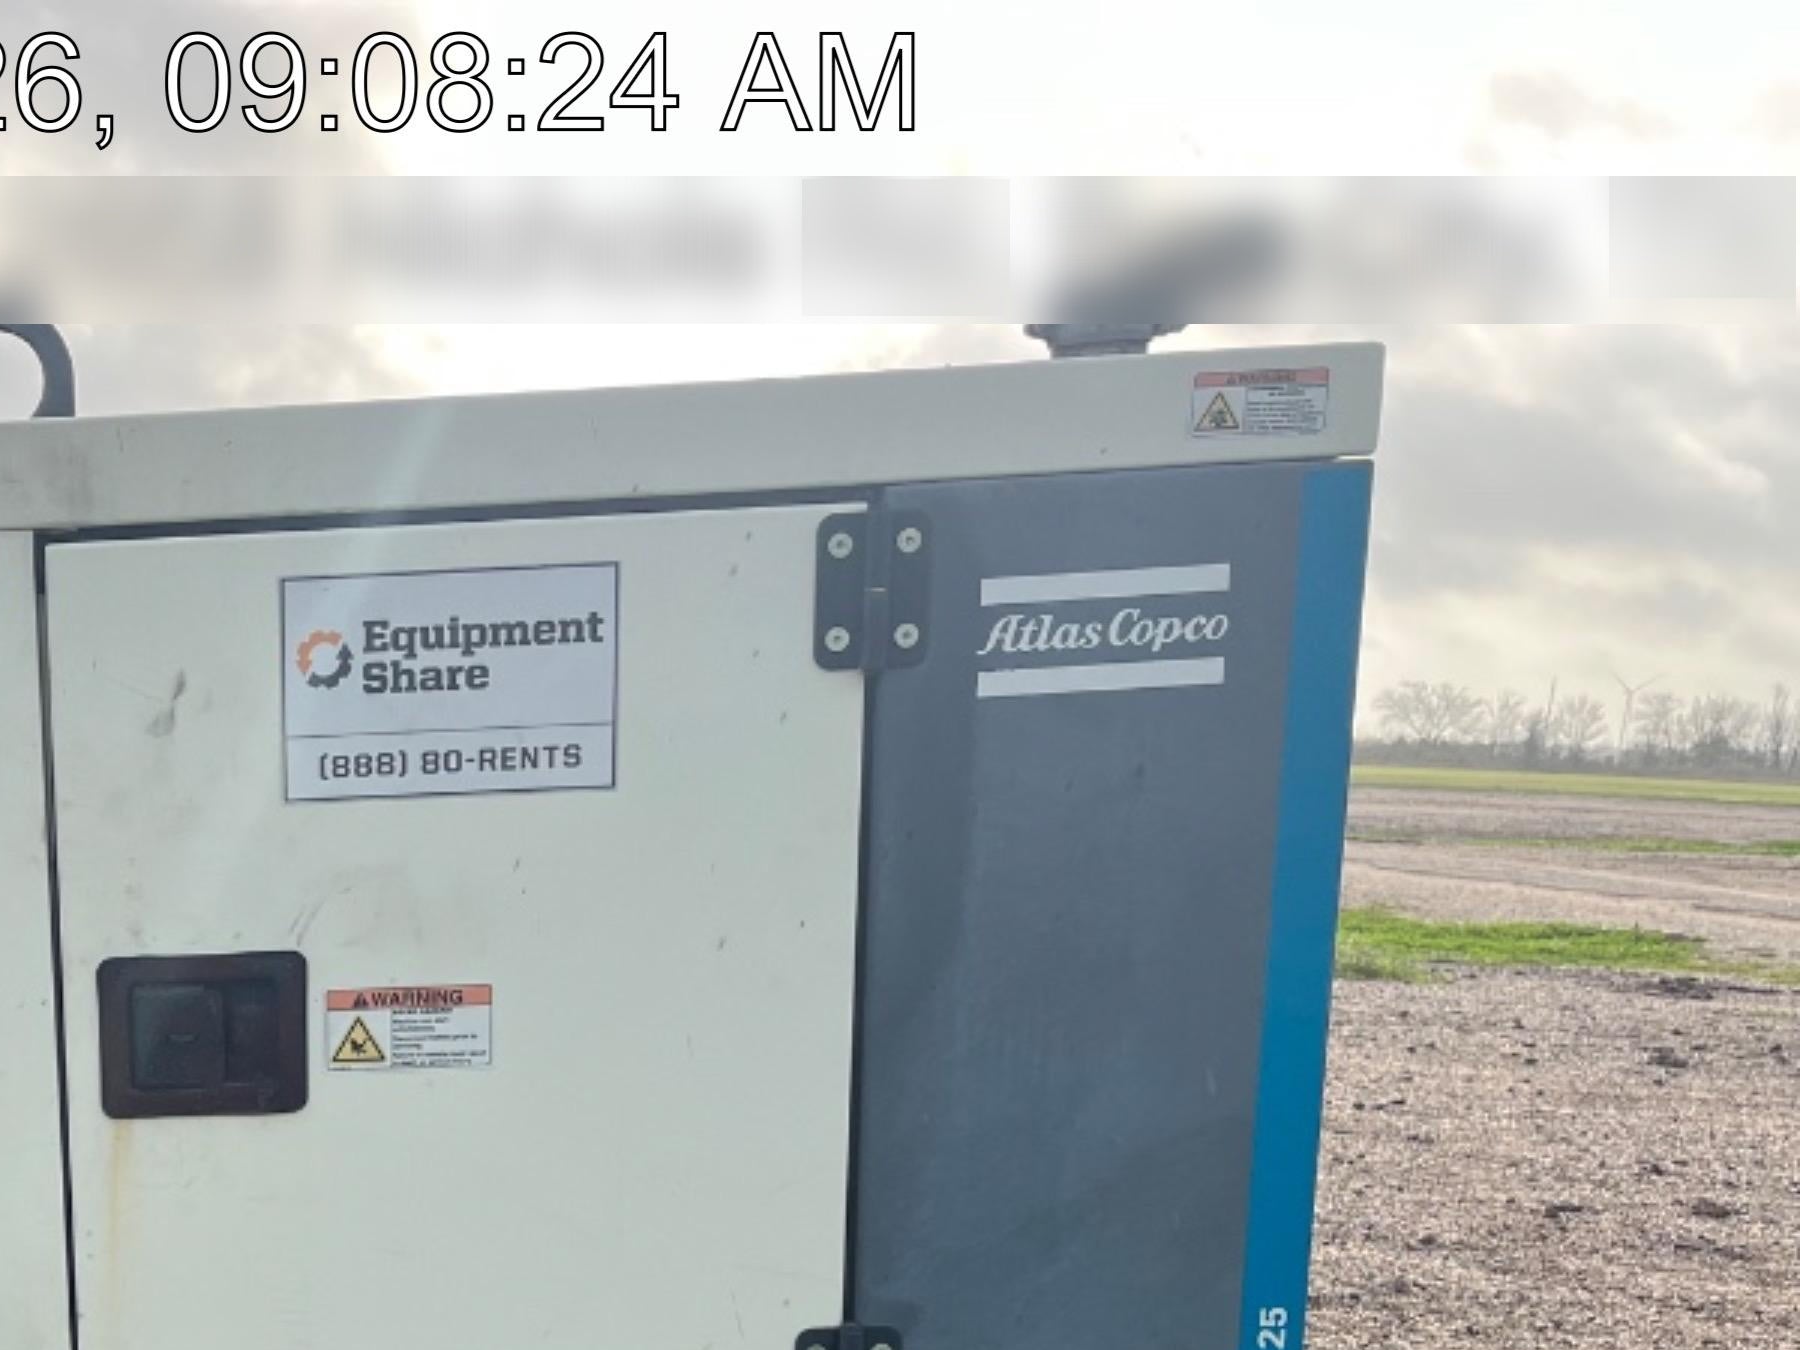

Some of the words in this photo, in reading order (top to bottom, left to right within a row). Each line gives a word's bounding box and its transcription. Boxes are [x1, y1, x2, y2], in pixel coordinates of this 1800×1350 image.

[362, 612, 605, 658] Equipment
[976, 614, 1102, 655] Atlas
[1108, 608, 1230, 652] Copco
[362, 661, 491, 694] Share
[319, 752, 408, 780] (888)
[421, 744, 583, 775] 80-RENTS
[372, 989, 463, 1007] WARNING
[1257, 1306, 1288, 1350] 25
